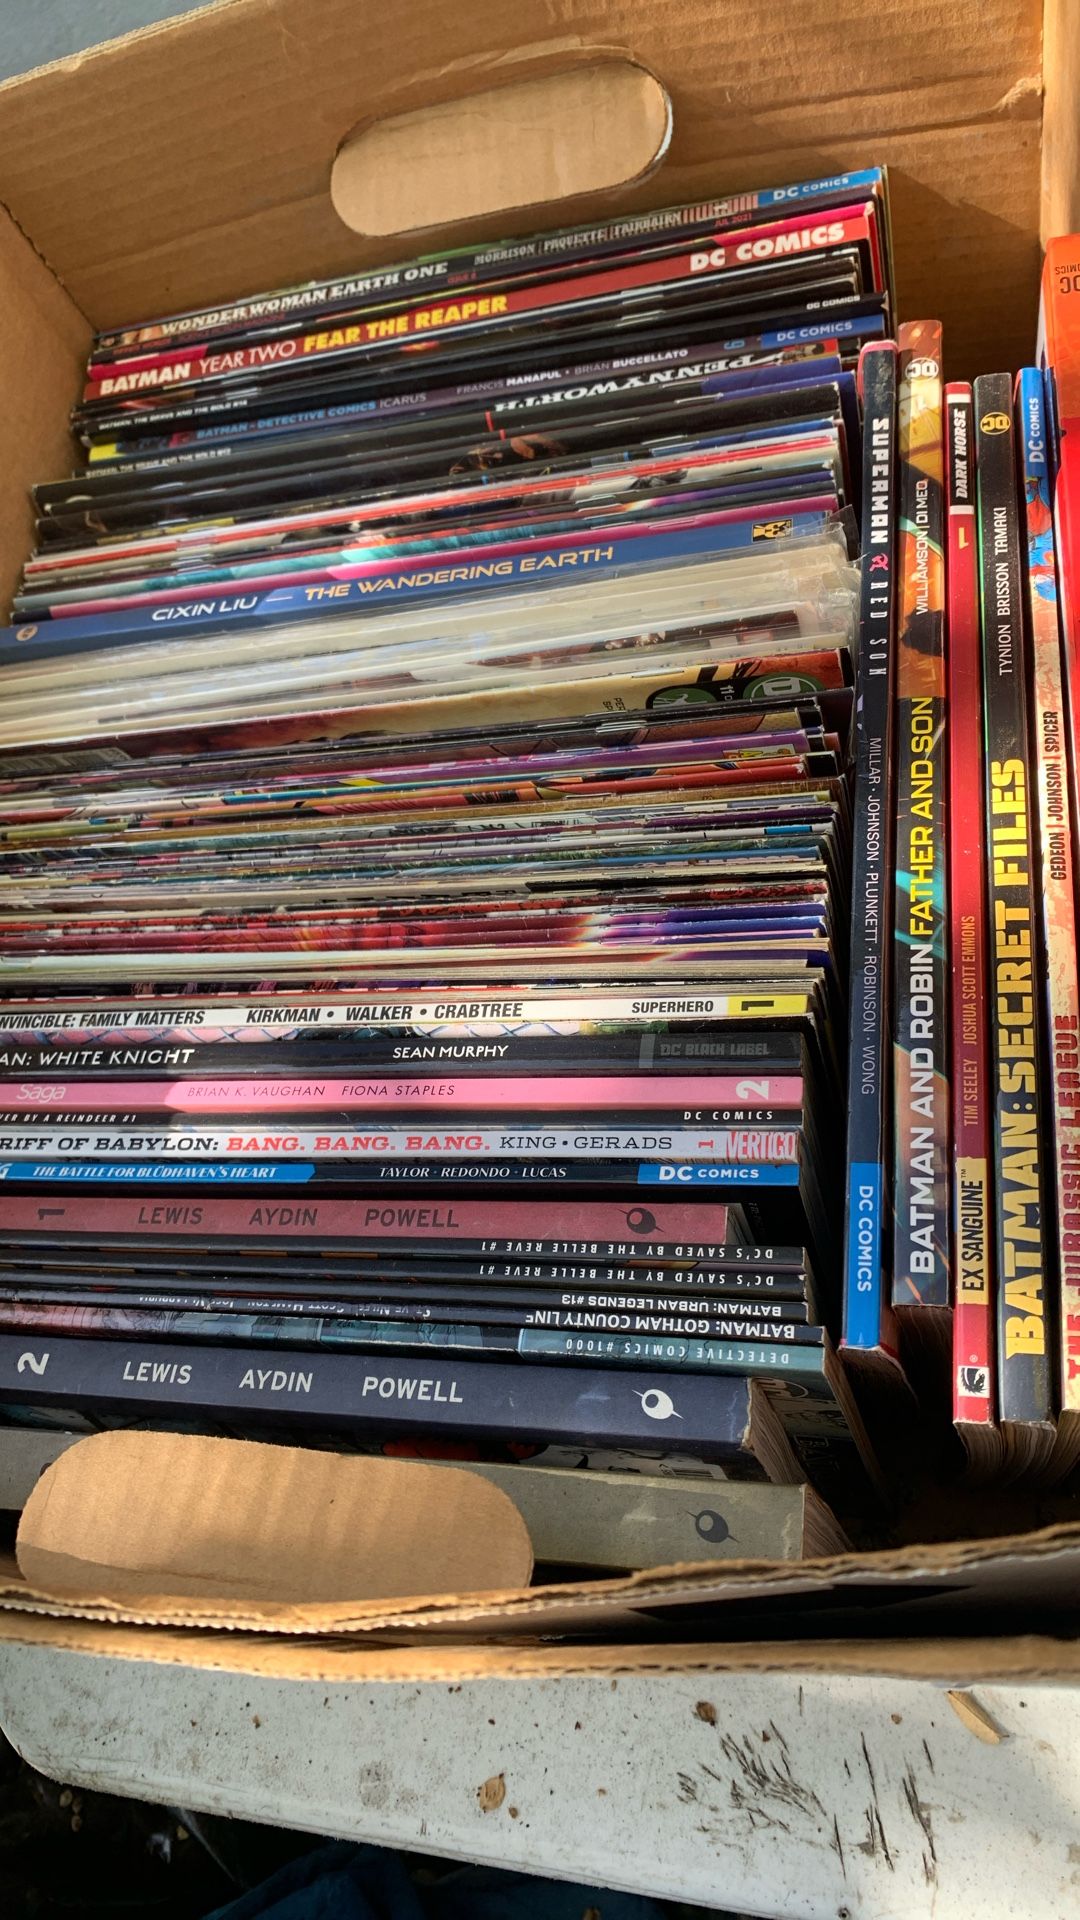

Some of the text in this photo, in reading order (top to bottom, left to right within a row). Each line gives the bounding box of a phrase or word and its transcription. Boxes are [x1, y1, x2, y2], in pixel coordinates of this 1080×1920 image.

[773, 177, 849, 201] DC COMICS
[474, 244, 535, 265] MORRISON
[690, 224, 845, 272] DC COMICS
[161, 305, 250, 334] WONDER
[249, 288, 327, 316] WOMAN
[328, 273, 400, 299] EARTH
[404, 262, 448, 281] ONE
[822, 294, 861, 307] COMICS
[777, 321, 853, 342] DC COMICS
[101, 363, 191, 395] BATMAN
[200, 352, 243, 374] YEAR
[249, 340, 296, 363] TWO
[303, 325, 361, 352] FEAR
[366, 316, 408, 338] THE
[415, 295, 508, 331] REAPER
[456, 349, 688, 395] FRANCIS MANAPUL BRIAN BUCCELLATO
[495, 354, 754, 412] PENNYWORTH
[196, 392, 427, 439] BATMAN DETECTIVE COMICS ICARUS
[1028, 397, 1045, 463] DC COMICS
[954, 408, 968, 499] DARK HORSE
[870, 417, 889, 619] SUPERMAN RED
[958, 527, 969, 549] 1
[151, 545, 614, 622] CIXIN LIU THE WANDERING EARTH
[915, 529, 930, 615] WILLIAMSON
[994, 506, 1012, 676] TYNION BRISSON TAMAKI
[1042, 710, 1068, 881] GEDEON JOHNSON SPICER
[861, 737, 882, 1095] MILLAR JOHNSON PLUNKETT ROBINSON WONG
[909, 696, 935, 1274] BATMAN AND ROBIN FATHER AND SON
[961, 915, 977, 1045] JOSHUA SCOTT EMMONS
[246, 1002, 523, 1023] KIRKMAN WALKER CRABTREE
[631, 1000, 714, 1014] SUPERHERO
[741, 1000, 775, 1011] 1
[79, 1010, 206, 1026] FAMILY MATTERS
[39, 1048, 196, 1066] WHITE KNIGHT
[392, 1044, 509, 1059] SEAN MURPHY
[660, 1042, 770, 1057] DC BLACK LABEL
[991, 758, 1045, 1360] BATMAN: SECRET FILES
[16, 1084, 67, 1105] Saga
[187, 1084, 456, 1098] BRIAN K. VAUGHAN FIONA STAPLES
[735, 1079, 770, 1100] 2
[963, 1058, 979, 1127] TIM SEELEY
[23, 1113, 39, 1122] BY
[56, 1113, 118, 1123] REINDEER
[683, 1110, 775, 1121] DC COMICS
[58, 1135, 490, 1151] OF BABYLON: BANG. BANG. BANG.
[499, 1135, 673, 1150] KING GERADS
[725, 1131, 796, 1159] VERTIGO
[1054, 1014, 1080, 1298] JURASSIC LEAGUE
[33, 1166, 279, 1178] THE BATTLE FOR HEART
[379, 1167, 567, 1178] TAYLOR REDONDO LUCAS
[659, 1166, 760, 1181] DC COMICS
[38, 1208, 65, 1221] 1
[138, 1207, 460, 1228] LEWIS AYDIN POWELL
[857, 1184, 874, 1293] DC COMICS
[961, 1180, 984, 1292] EX SANGUINE
[480, 1240, 774, 1260] DC'S SAVED BY THE BELLE REVE #1
[478, 1264, 774, 1287] DC'S SAVED BY THE BELLE REVE #1
[561, 1294, 782, 1317] BATMAN: URBAN LEGENDS #13
[562, 1312, 795, 1339] BATMAN: GOTHAM COUNTY
[565, 1337, 790, 1364] DETECTIVE COMICS #1000
[17, 1351, 50, 1375] 2
[123, 1360, 463, 1403] LEWIS AYDIN POWELL
